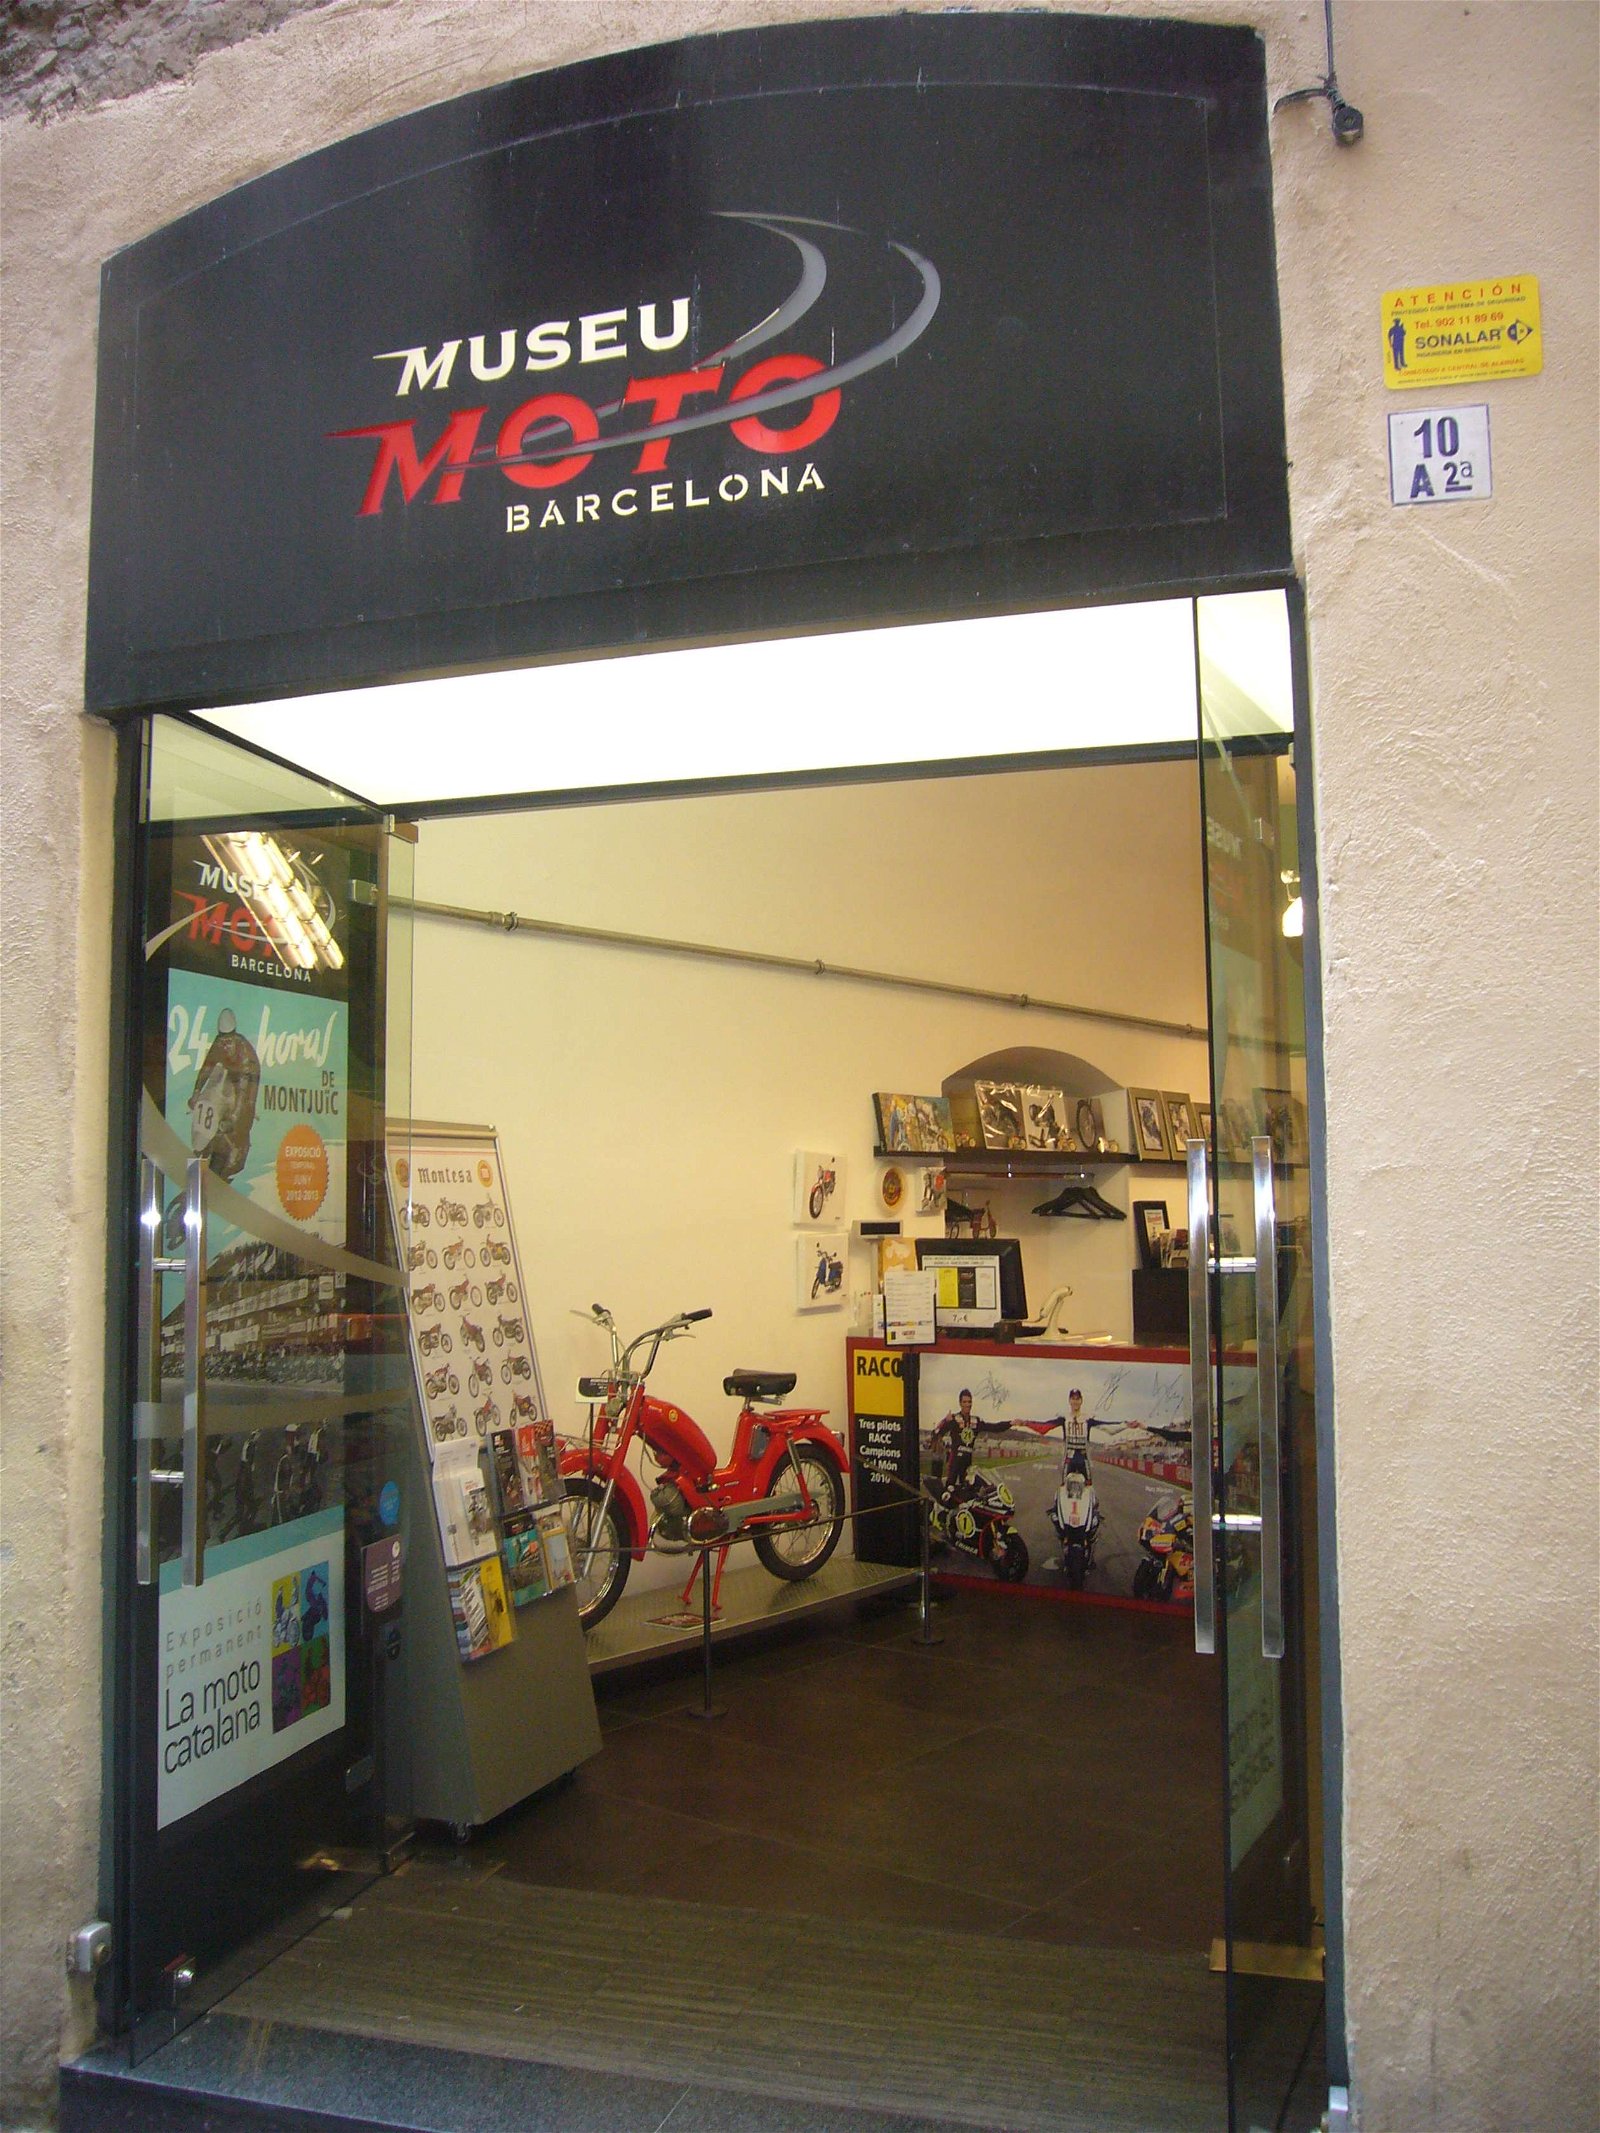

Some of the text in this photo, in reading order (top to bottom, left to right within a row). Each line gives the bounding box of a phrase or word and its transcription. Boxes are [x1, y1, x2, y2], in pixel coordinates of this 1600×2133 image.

[1394, 283, 1521, 307] ATENCIÓN
[1435, 316, 1455, 327] 902
[1459, 315, 1470, 324] 11
[373, 297, 691, 396] MUSEU
[1415, 328, 1501, 349] SONALAR
[324, 353, 842, 515] MOTO
[1413, 416, 1460, 459] 10
[1410, 464, 1435, 499] A
[505, 462, 826, 533] BARCELONA
[231, 953, 312, 983] BARCELONA
[168, 1004, 213, 1076] 24
[321, 1070, 335, 1088] DE
[197, 1103, 214, 1130] 18
[418, 1167, 473, 1184] Montesa
[859, 1418, 901, 1433] Tres pilots
[868, 1432, 892, 1445] RACC
[860, 1445, 901, 1459] Campions
[878, 1459, 898, 1472] Món
[166, 1598, 262, 1652] Exposició
[166, 1625, 262, 1684] permanent
[165, 1660, 261, 1731] La moto
[165, 1700, 261, 1774] catalana
